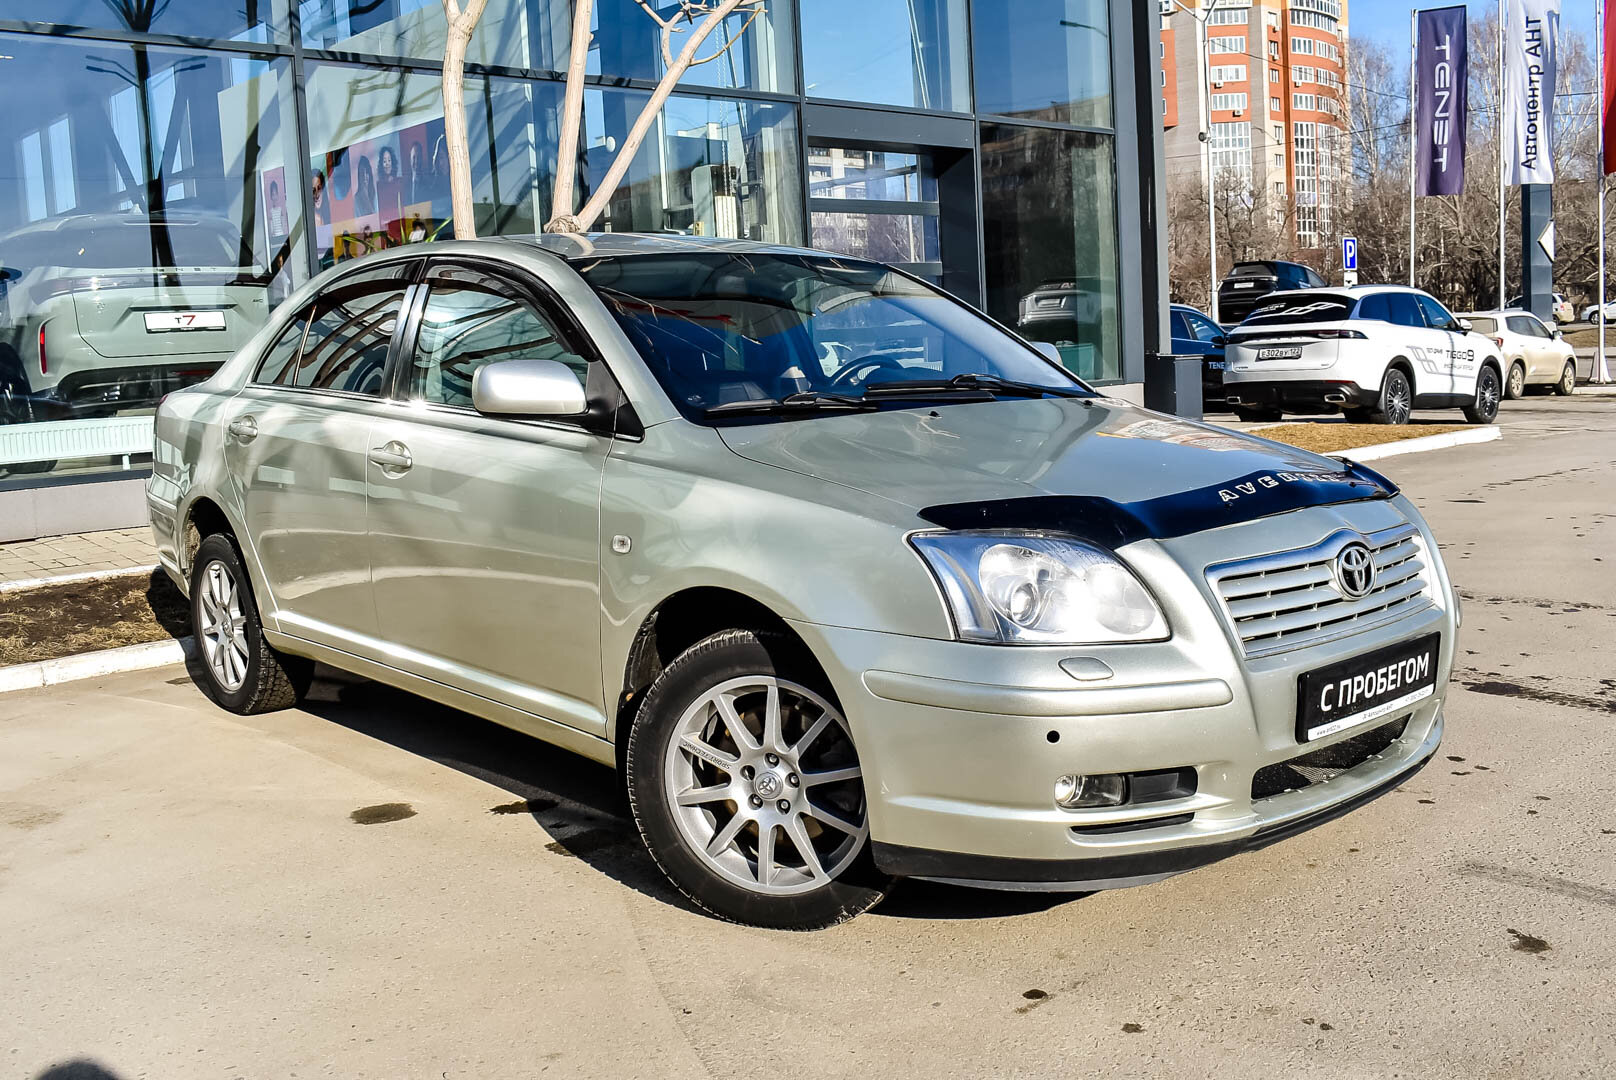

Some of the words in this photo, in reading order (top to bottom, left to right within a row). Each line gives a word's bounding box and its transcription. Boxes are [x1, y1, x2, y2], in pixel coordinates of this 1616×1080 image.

[1525, 16, 1541, 58] АНТ
[1434, 34, 1450, 173] TENET
[1521, 64, 1545, 169] Автоцентр
[1346, 241, 1355, 267] P
[175, 315, 196, 326] T7
[1208, 361, 1225, 369] TENE
[1320, 683, 1334, 712] С
[1337, 651, 1430, 708] ПРОБЕГОМ
